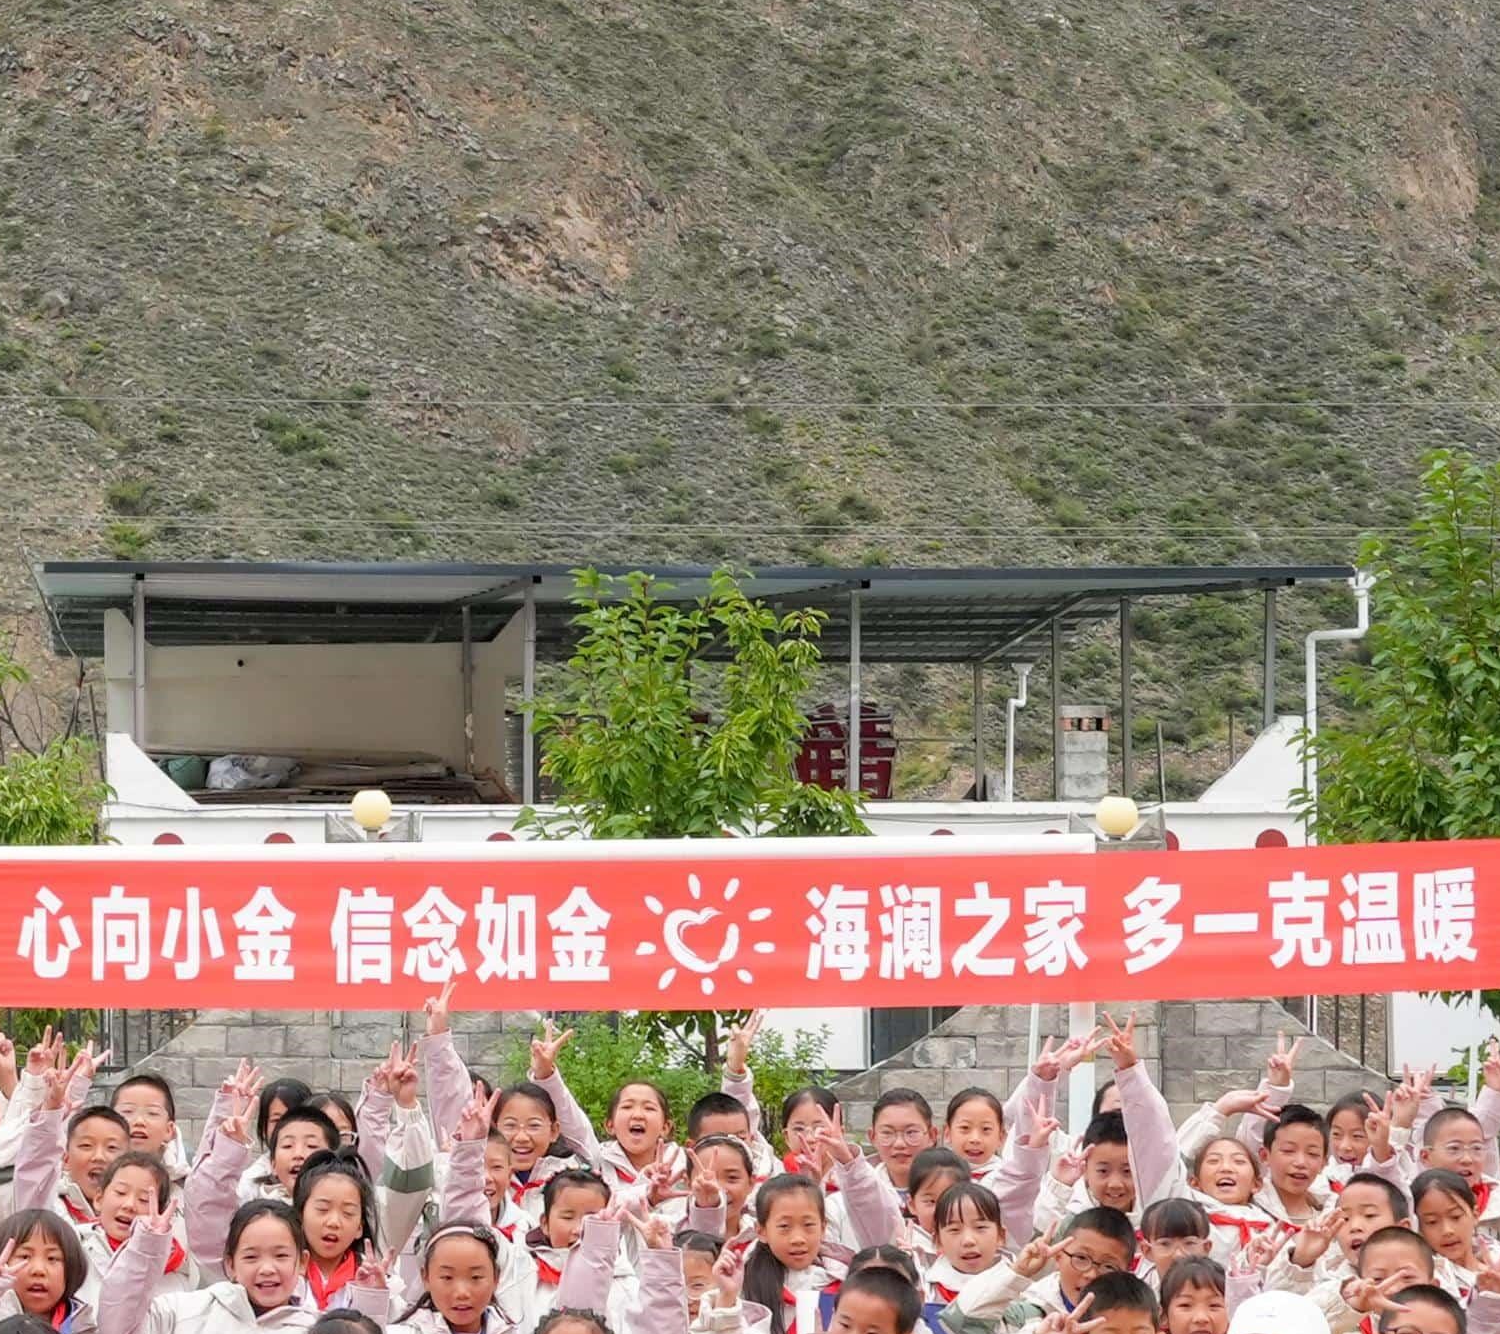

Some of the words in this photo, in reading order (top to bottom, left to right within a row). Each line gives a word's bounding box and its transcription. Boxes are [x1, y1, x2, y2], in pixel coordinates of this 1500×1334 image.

[17, 886, 296, 981] 心向小金
[331, 886, 612, 985] 信念如金
[805, 880, 1089, 981] 海澜之家
[1122, 866, 1478, 970] 多一克温暖
